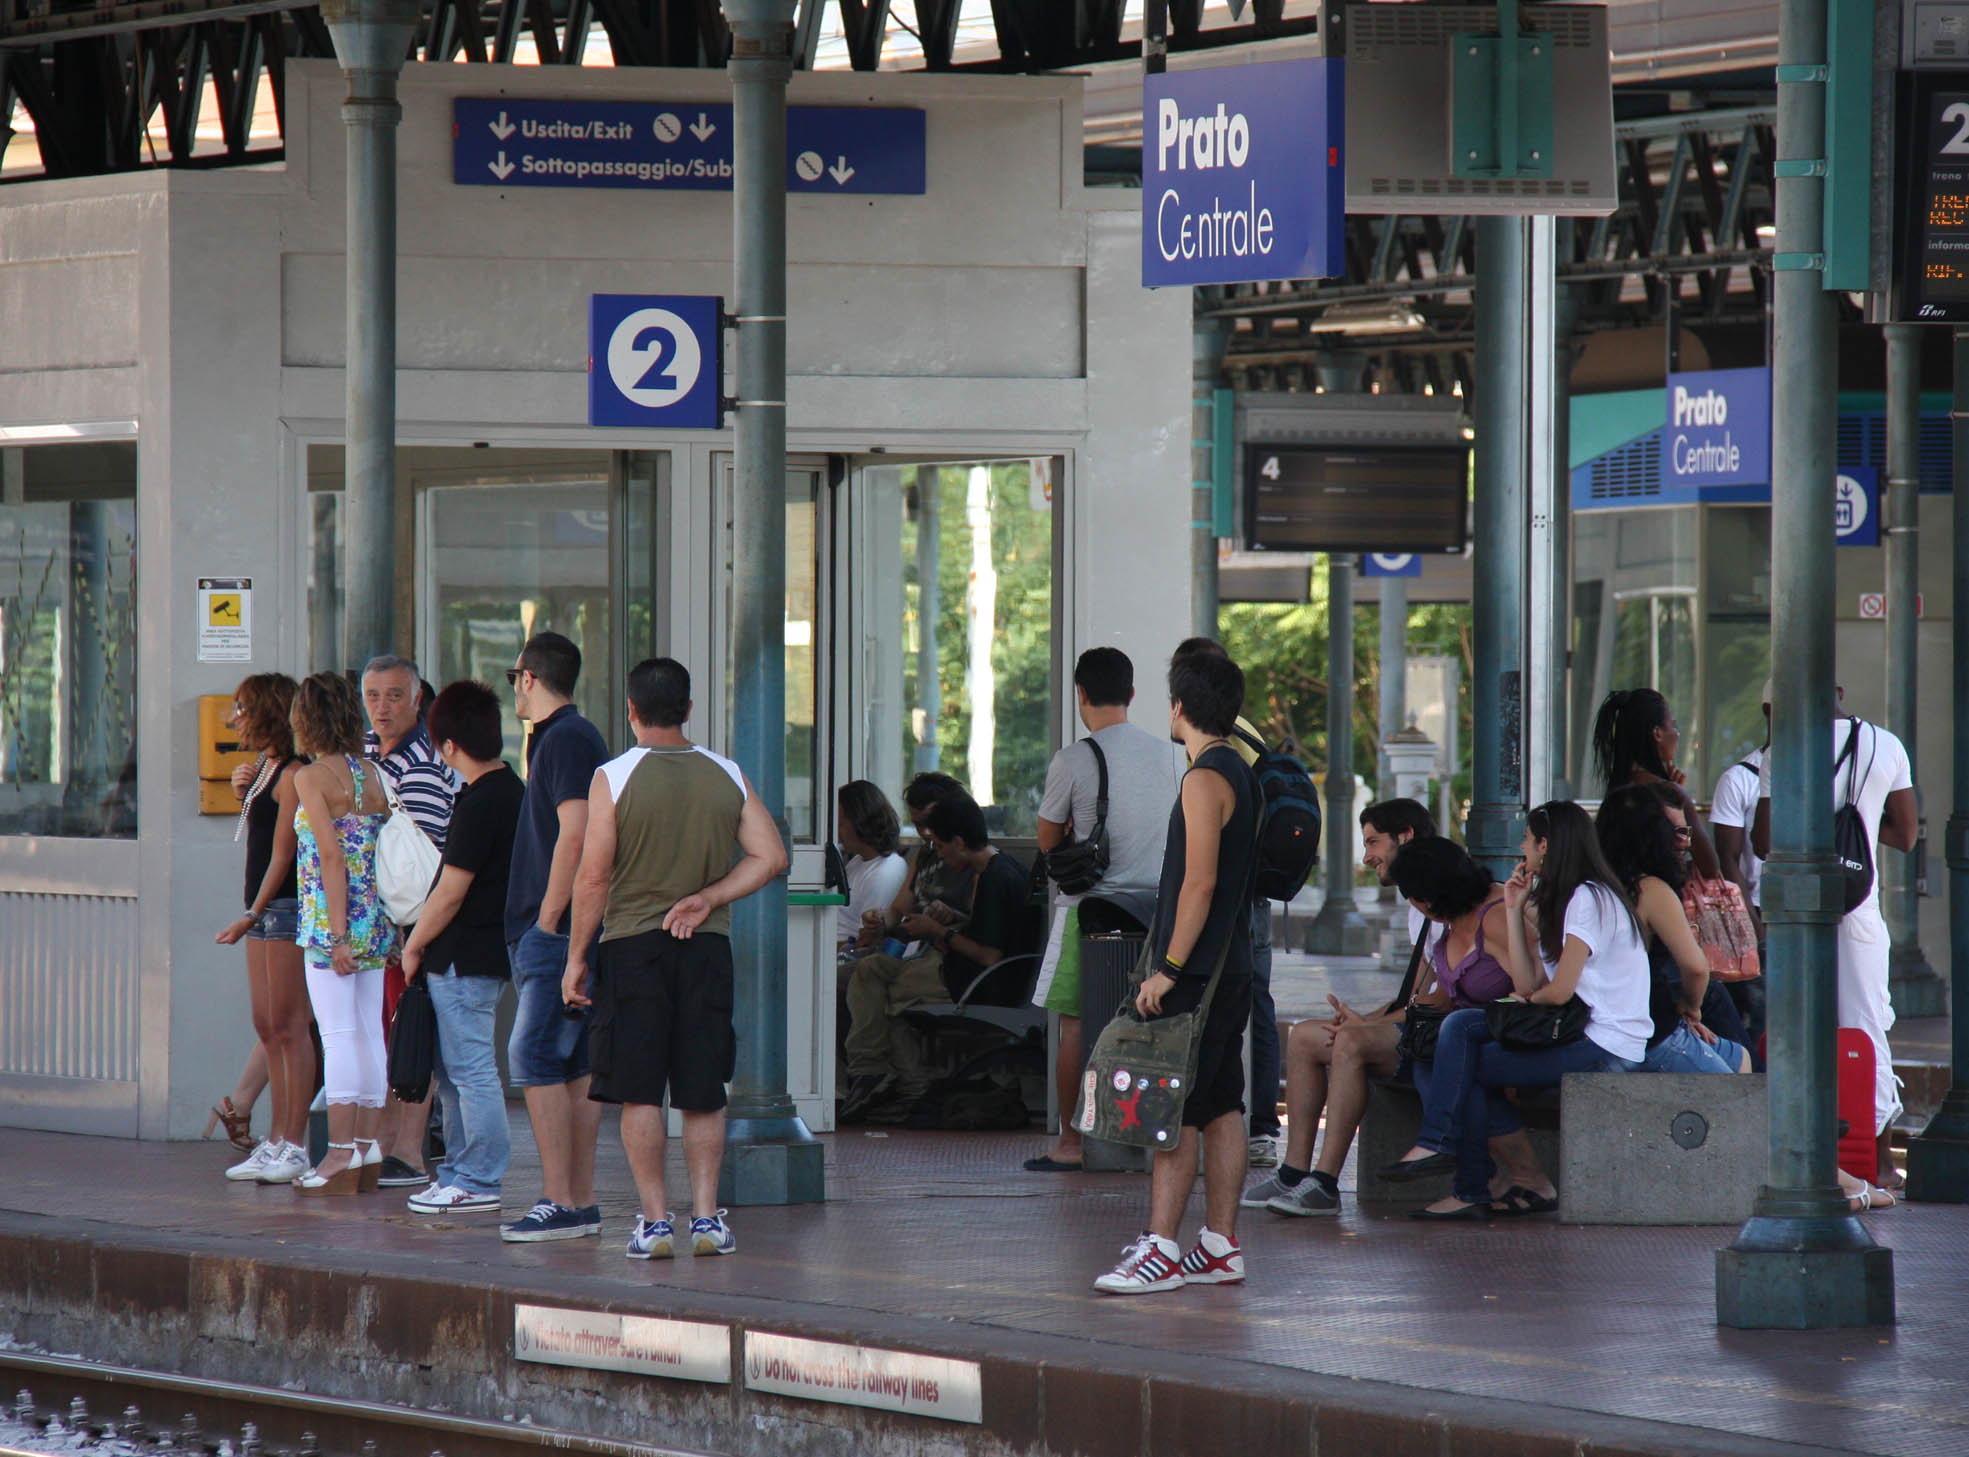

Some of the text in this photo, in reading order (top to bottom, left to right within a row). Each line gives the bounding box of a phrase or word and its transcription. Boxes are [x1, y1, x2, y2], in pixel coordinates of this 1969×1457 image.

[521, 119, 633, 140] Uscita/Exit
[1158, 98, 1249, 172] Prato
[1939, 101, 1969, 154] 2
[521, 154, 734, 181] Sottopassaggio/Sub
[1157, 179, 1274, 262] Centrale
[632, 326, 678, 390] 2
[1674, 385, 1727, 427] Prato
[1261, 457, 1280, 481] 4
[1673, 430, 1740, 475] Centrale
[764, 1355, 780, 1380] Do
[862, 1366, 908, 1405] railway
[911, 1370, 939, 1403] lines
